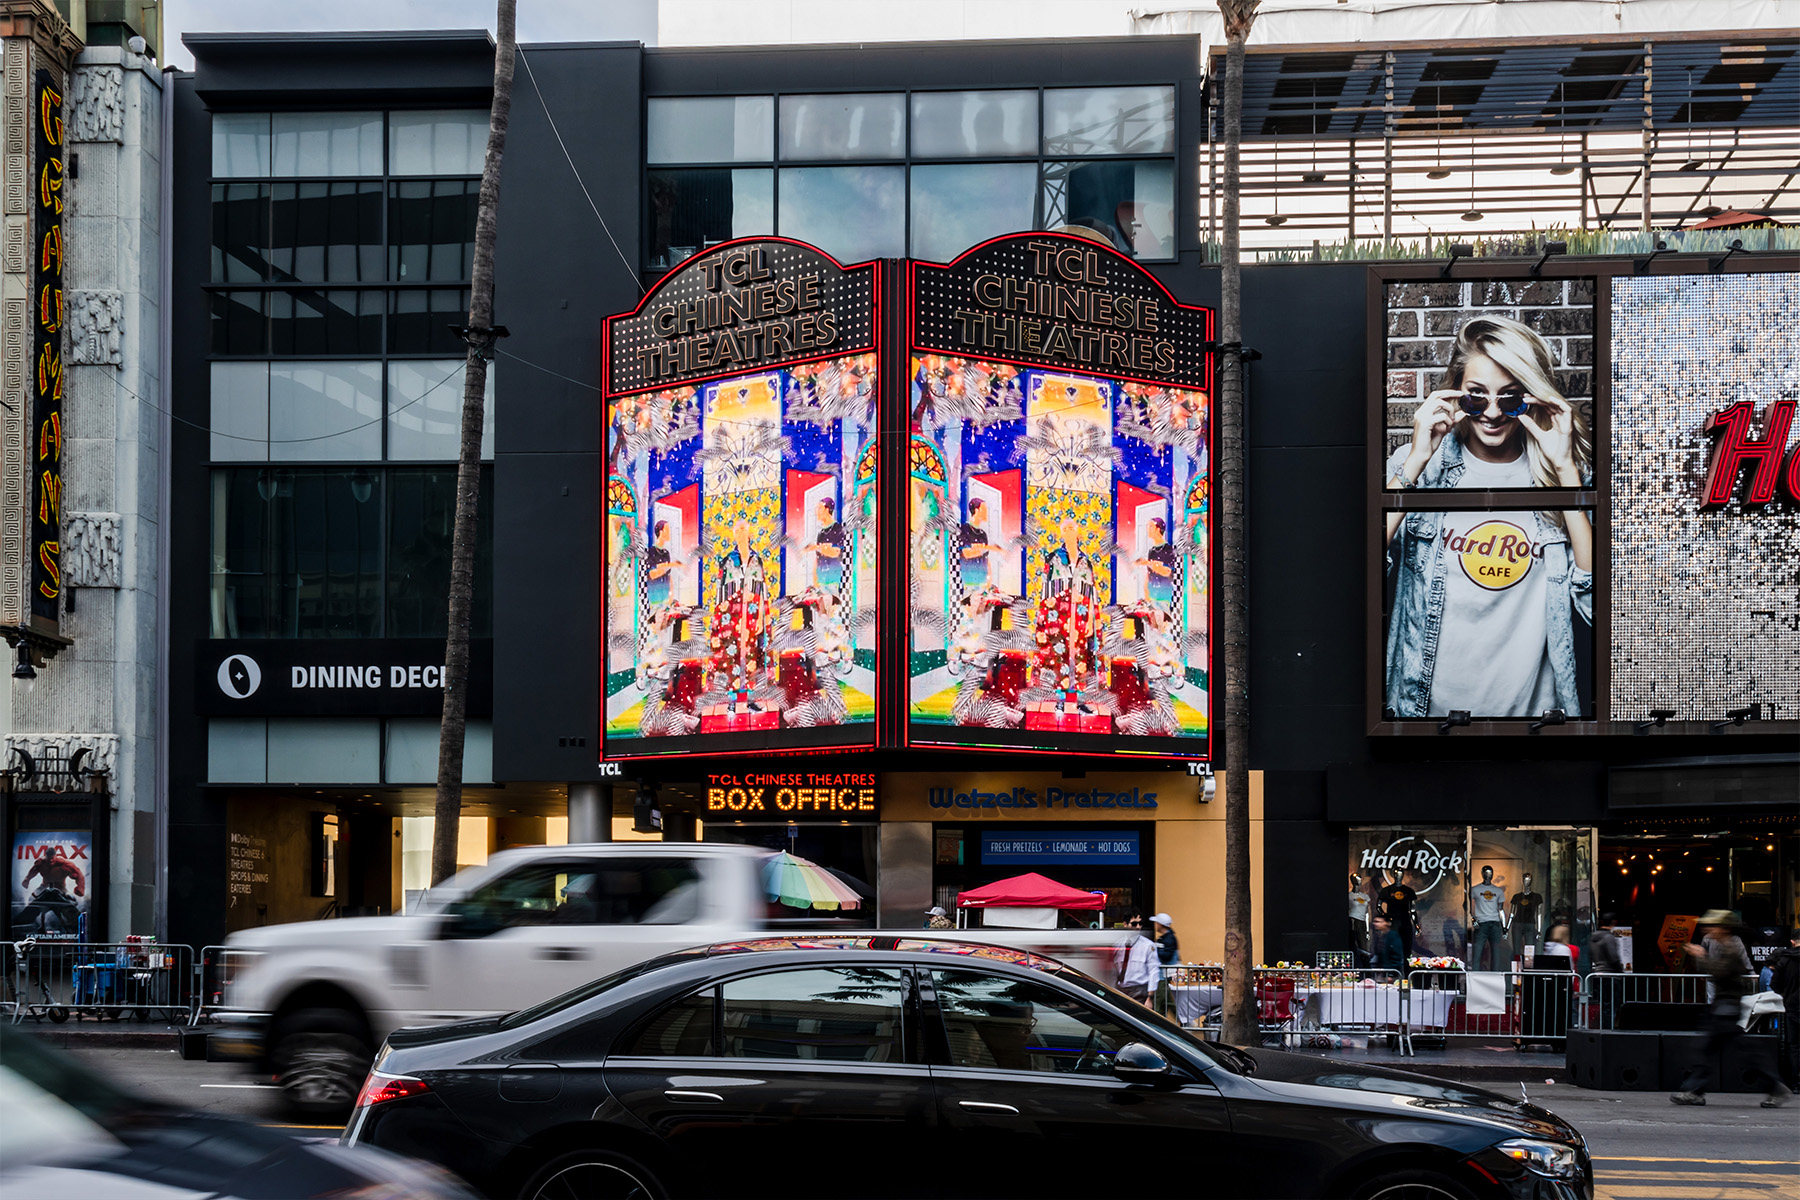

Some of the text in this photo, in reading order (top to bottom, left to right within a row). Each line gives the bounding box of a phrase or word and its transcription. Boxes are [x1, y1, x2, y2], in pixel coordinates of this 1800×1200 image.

[698, 248, 770, 290] TCL
[1029, 242, 1107, 286] TCL
[652, 275, 820, 338] CHINESE
[973, 274, 1159, 332] CHINESE
[637, 312, 838, 379] THEATRES
[953, 310, 1175, 373] THEATRES
[1498, 534, 1544, 564] Roc
[1478, 566, 1511, 577] CAFE
[292, 666, 381, 688] DINING
[598, 763, 622, 776] TCL
[708, 773, 876, 786] TCL CHINESE THEATRES
[1187, 762, 1213, 775] TCL
[708, 787, 876, 811] BOX OFFICE
[929, 787, 1159, 809] Wetzel's Pretzels
[17, 845, 89, 860] IMAX
[991, 842, 1131, 853] FRESH PRETZELS LEMONADE HOT DOGS
[1360, 849, 1463, 874] Hard Rock
